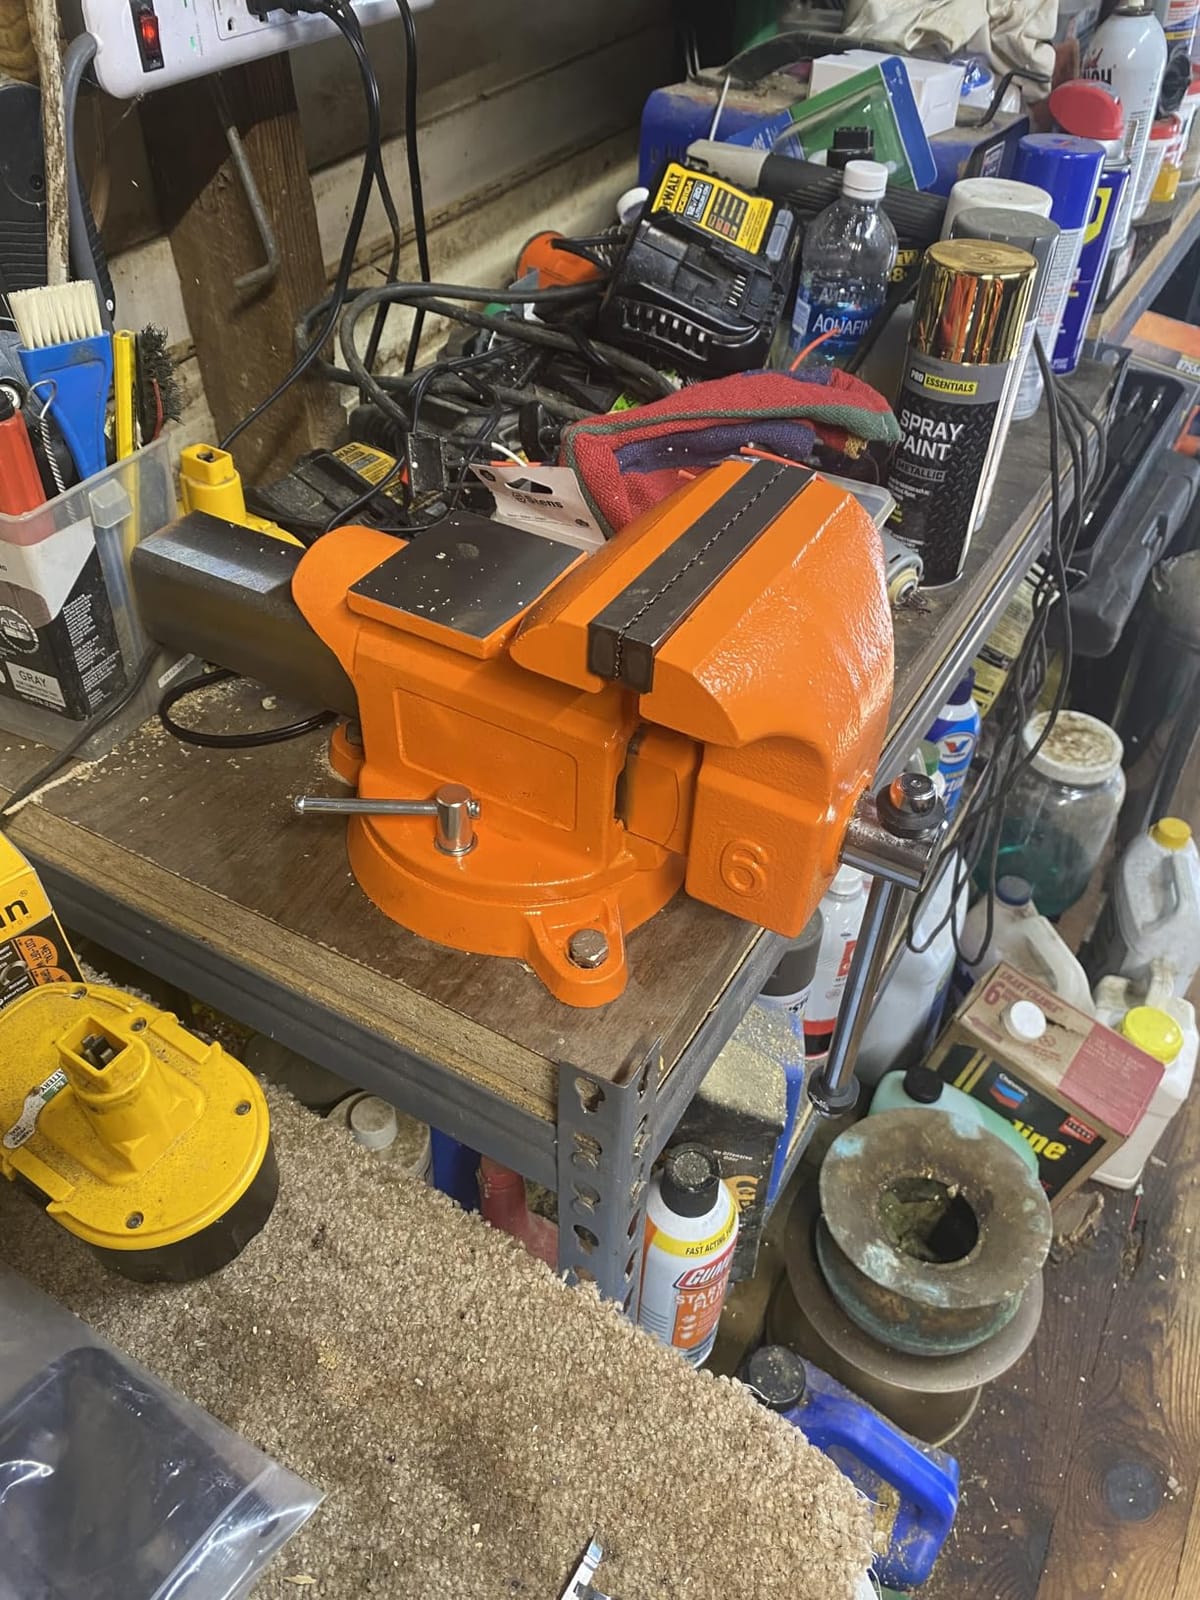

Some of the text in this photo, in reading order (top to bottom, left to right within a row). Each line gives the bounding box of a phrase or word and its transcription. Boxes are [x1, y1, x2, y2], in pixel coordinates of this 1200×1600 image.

[659, 172, 682, 210] EWALT
[812, 314, 873, 337] AQUAFIN
[910, 368, 975, 393] PRO ESSENTIALS
[900, 408, 964, 441] SPRAY
[18, 670, 47, 688] GRAY
[719, 839, 770, 898] 6
[1013, 1118, 1067, 1161] line
[684, 1246, 704, 1256] FAST
[685, 1254, 733, 1287] GUM
